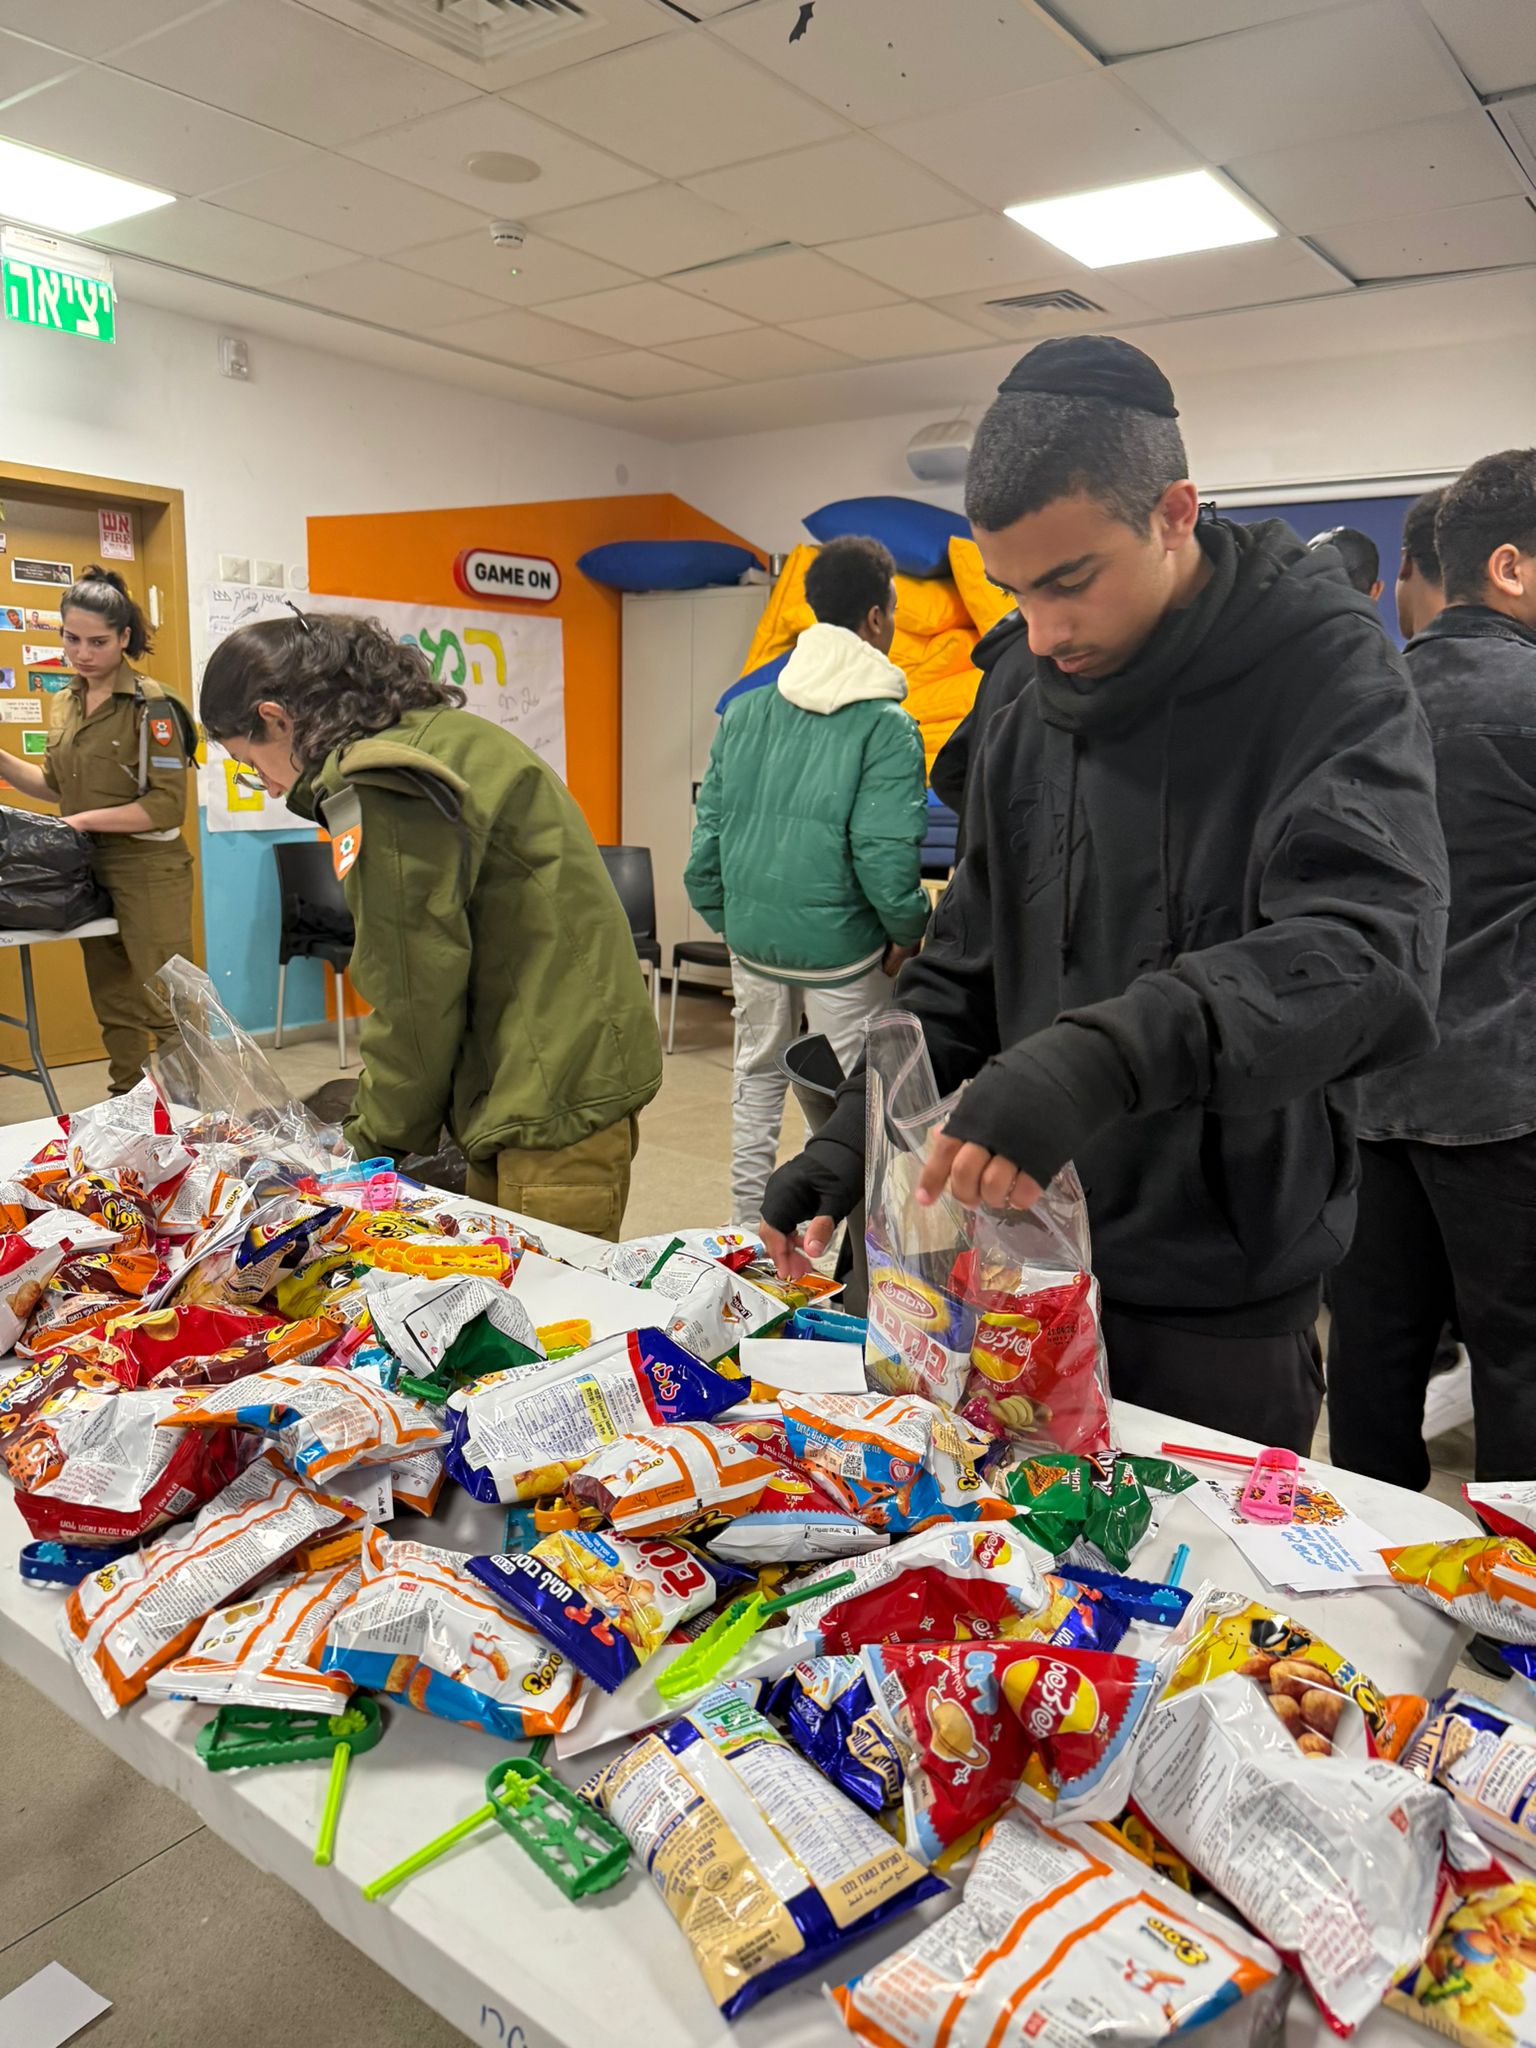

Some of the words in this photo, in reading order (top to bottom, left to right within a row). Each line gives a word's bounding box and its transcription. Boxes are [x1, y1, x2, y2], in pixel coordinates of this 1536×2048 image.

[8, 261, 110, 336] יציאה
[102, 512, 130, 533] אש
[103, 532, 131, 545] FIRE
[474, 562, 524, 585] GAME
[528, 569, 552, 590] ON
[896, 1291, 926, 1312] אסם
[1071, 1468, 1081, 1492] חמוץ
[540, 1572, 574, 1603] חטיף
